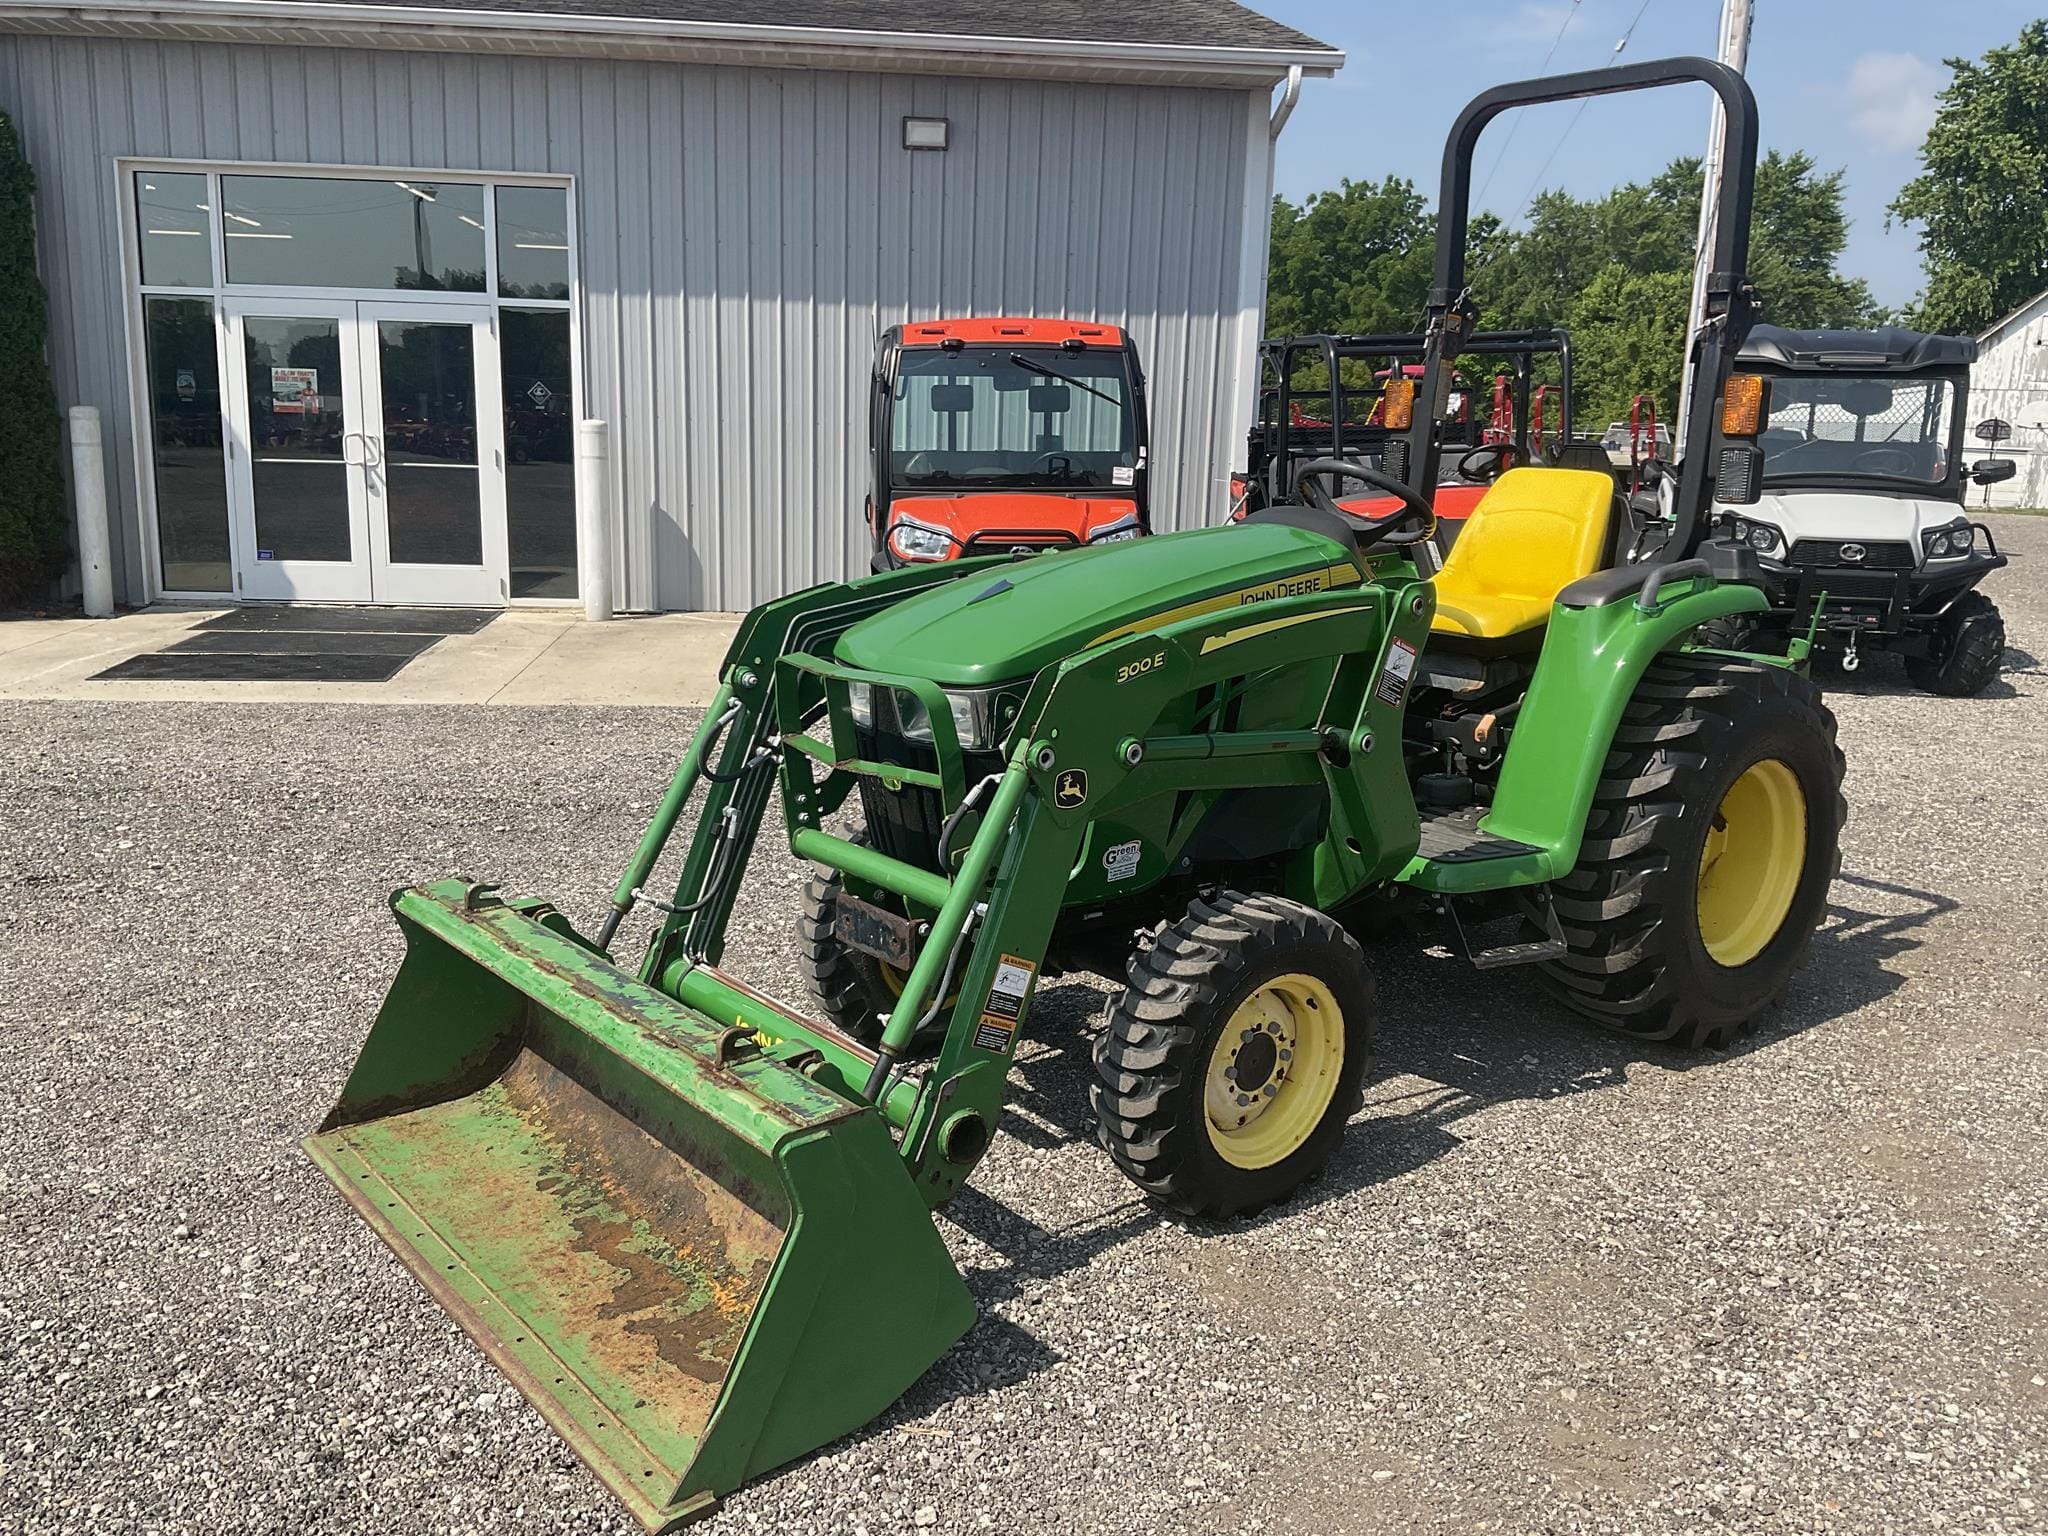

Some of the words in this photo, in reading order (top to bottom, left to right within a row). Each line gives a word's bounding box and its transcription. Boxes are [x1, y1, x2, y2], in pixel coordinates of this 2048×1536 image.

[1240, 587, 1276, 605] JOHN
[1277, 577, 1321, 599] DEERE
[1106, 845, 1136, 865] Green
[1010, 958, 1032, 969] WARNING
[989, 1018, 1012, 1029] WARNING
